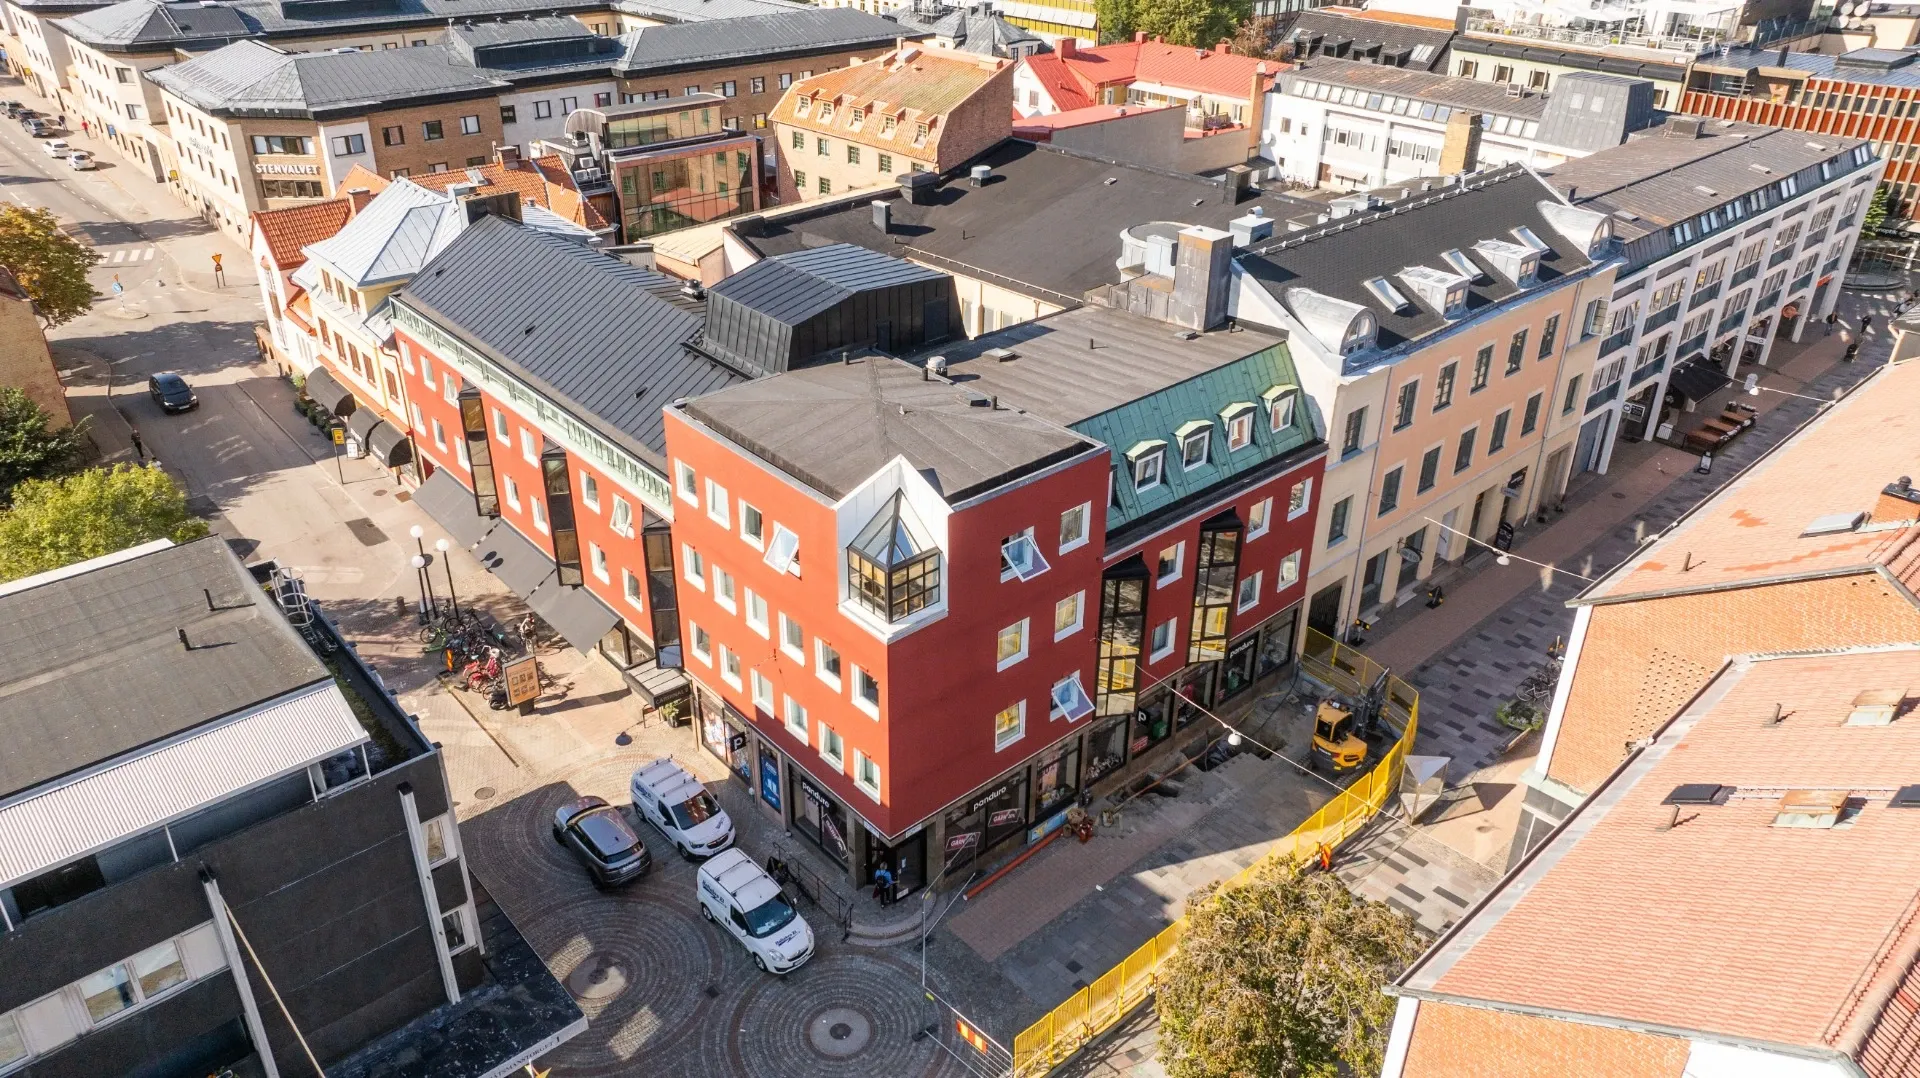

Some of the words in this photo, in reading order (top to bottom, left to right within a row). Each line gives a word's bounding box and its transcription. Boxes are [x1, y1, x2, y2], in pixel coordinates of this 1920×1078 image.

[255, 163, 319, 175] STENVALVET
[1229, 639, 1255, 659] panduro
[802, 781, 830, 808] panduro
[973, 786, 1007, 812] panduro
